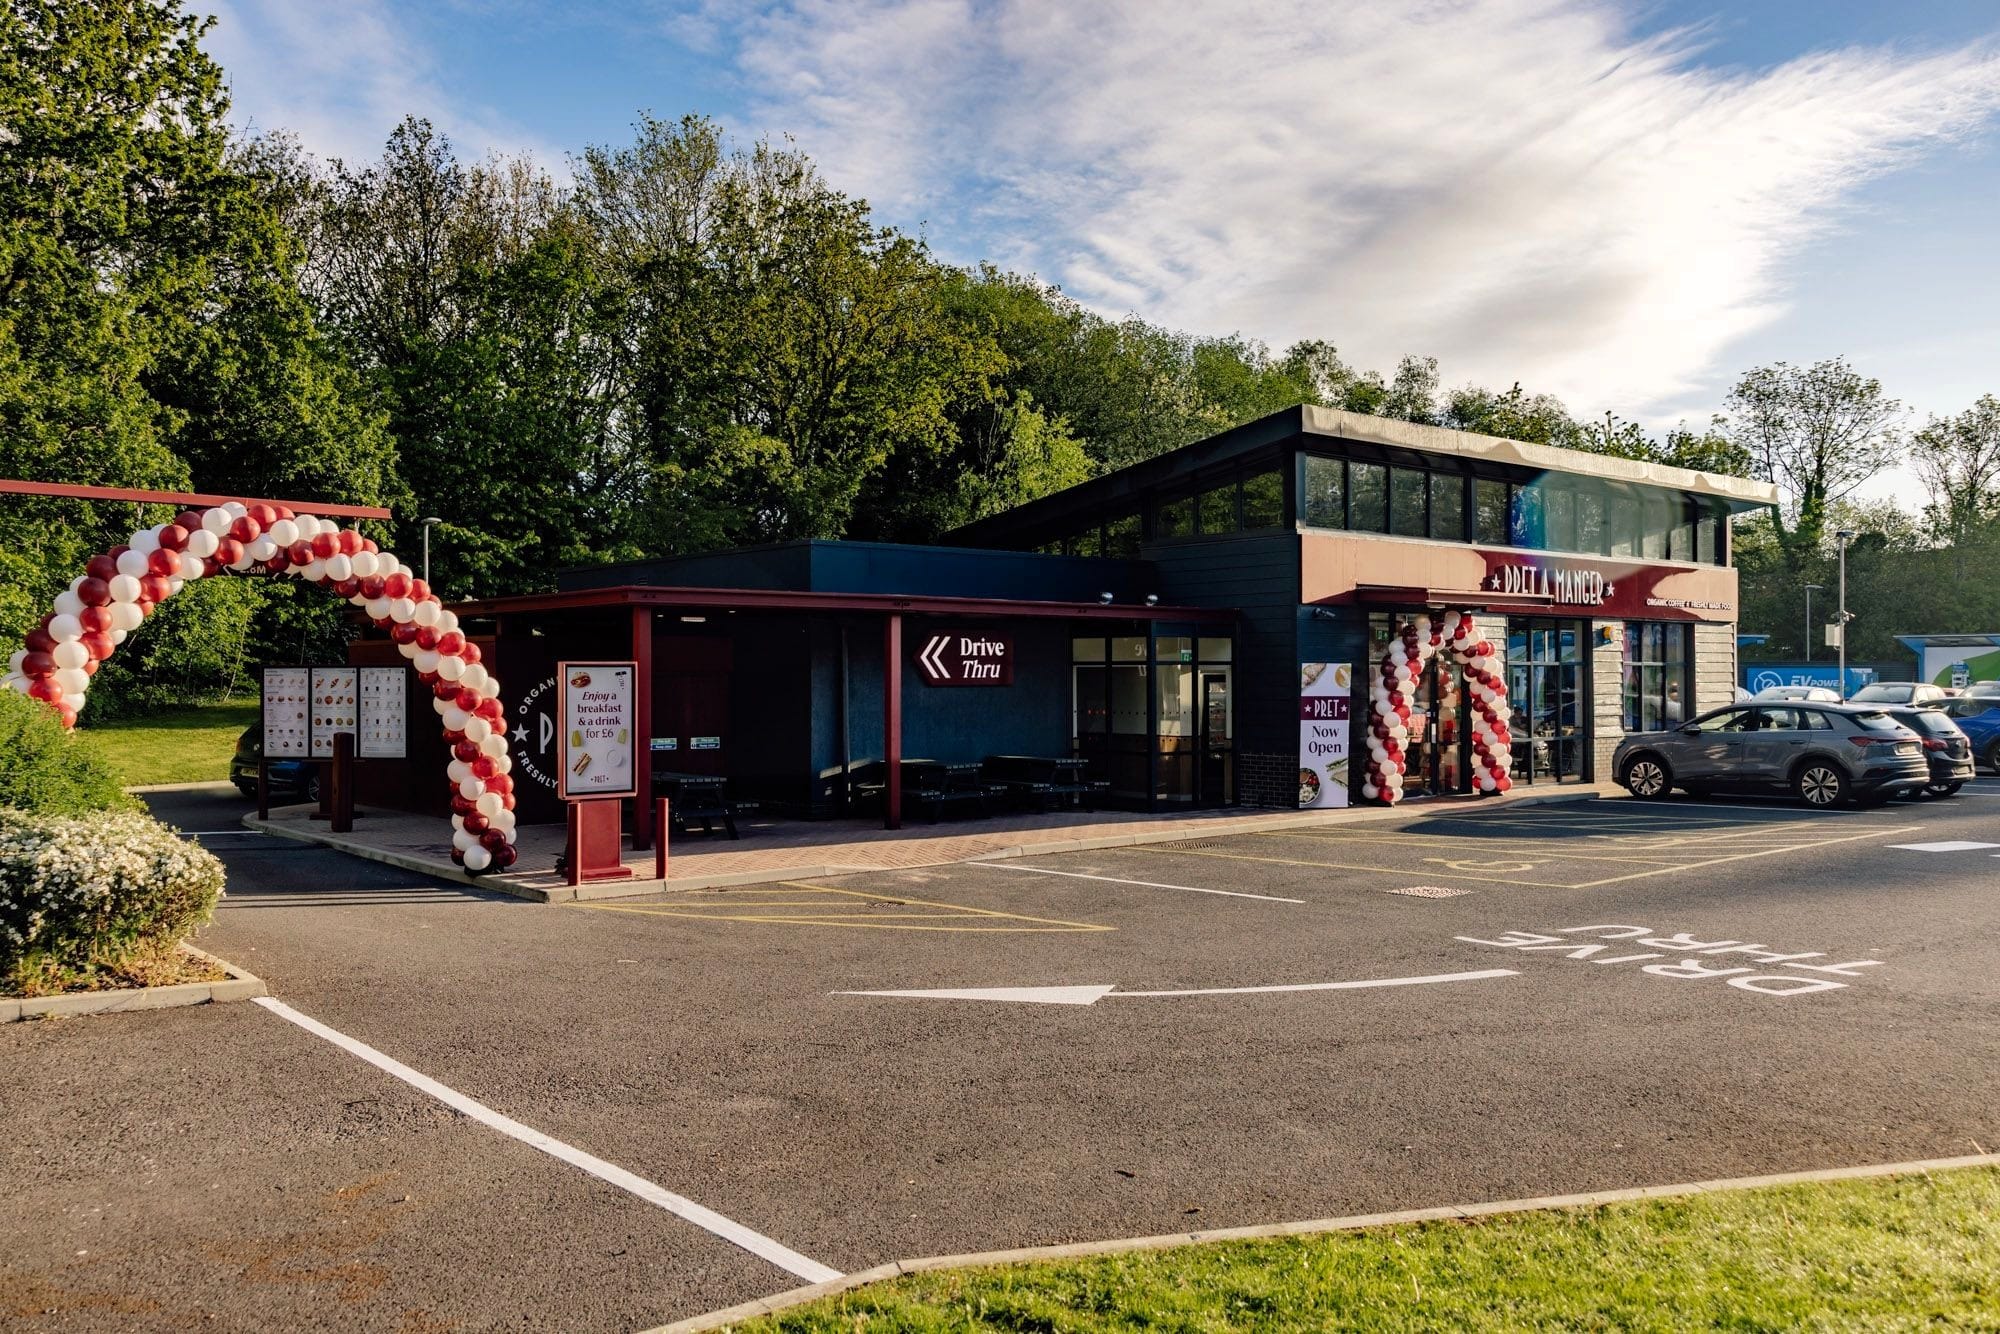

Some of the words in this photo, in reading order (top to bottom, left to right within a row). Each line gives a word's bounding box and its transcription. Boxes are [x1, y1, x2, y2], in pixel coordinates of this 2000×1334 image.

[1555, 568, 1604, 605] MANGER
[960, 637, 1005, 656] Drive
[962, 659, 1001, 678] Thru
[518, 677, 558, 714] ORGAN
[582, 691, 610, 702] Enjoy
[577, 703, 622, 713] breakfast
[1314, 699, 1340, 718] PRET
[578, 717, 586, 726] &
[595, 716, 621, 726] drink
[585, 729, 600, 739] for
[602, 728, 614, 738] £6
[1312, 725, 1339, 738] Now
[1308, 741, 1342, 757] Open
[518, 750, 559, 789] FRESHLY
[1555, 924, 1885, 977] THRU
[1453, 931, 1850, 996] DRIVE
